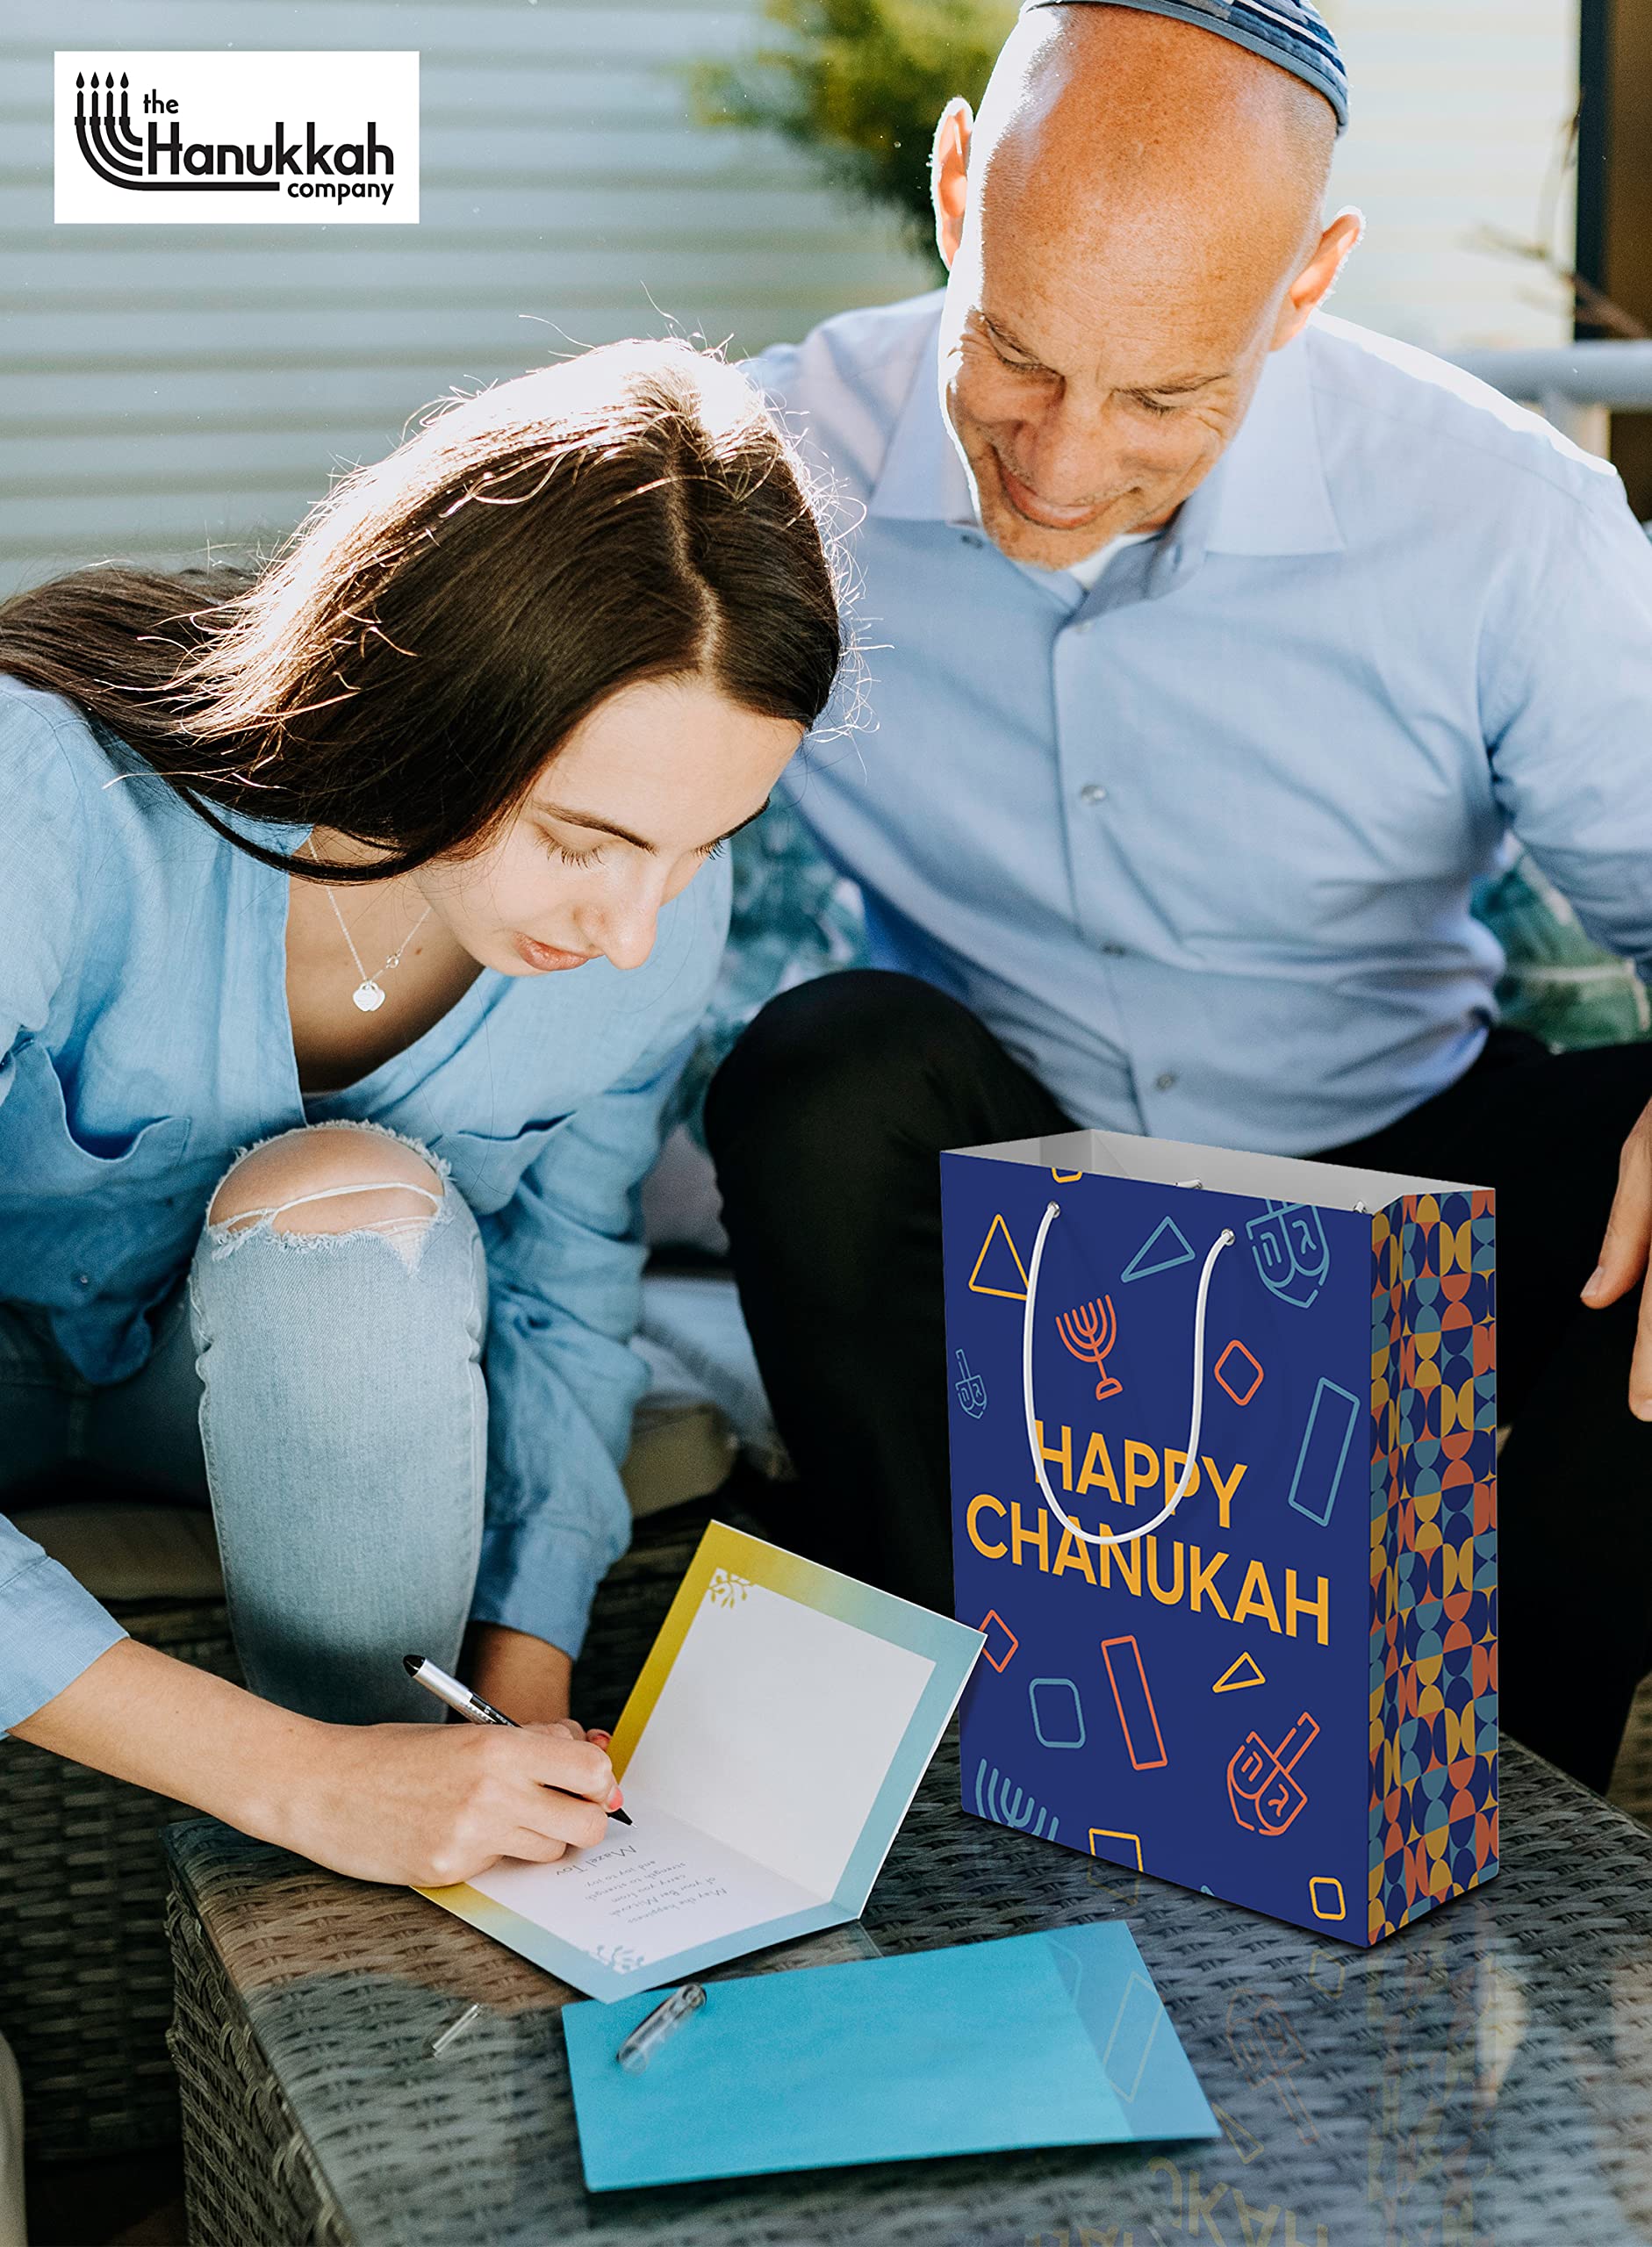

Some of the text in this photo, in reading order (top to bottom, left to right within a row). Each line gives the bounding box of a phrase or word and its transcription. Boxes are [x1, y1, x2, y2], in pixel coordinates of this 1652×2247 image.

[1034, 1419, 1248, 1528] HAPPY
[966, 1494, 1329, 1646] CHANUKAH
[556, 1845, 636, 1876] Mazel Tov
[638, 1860, 656, 1870] and
